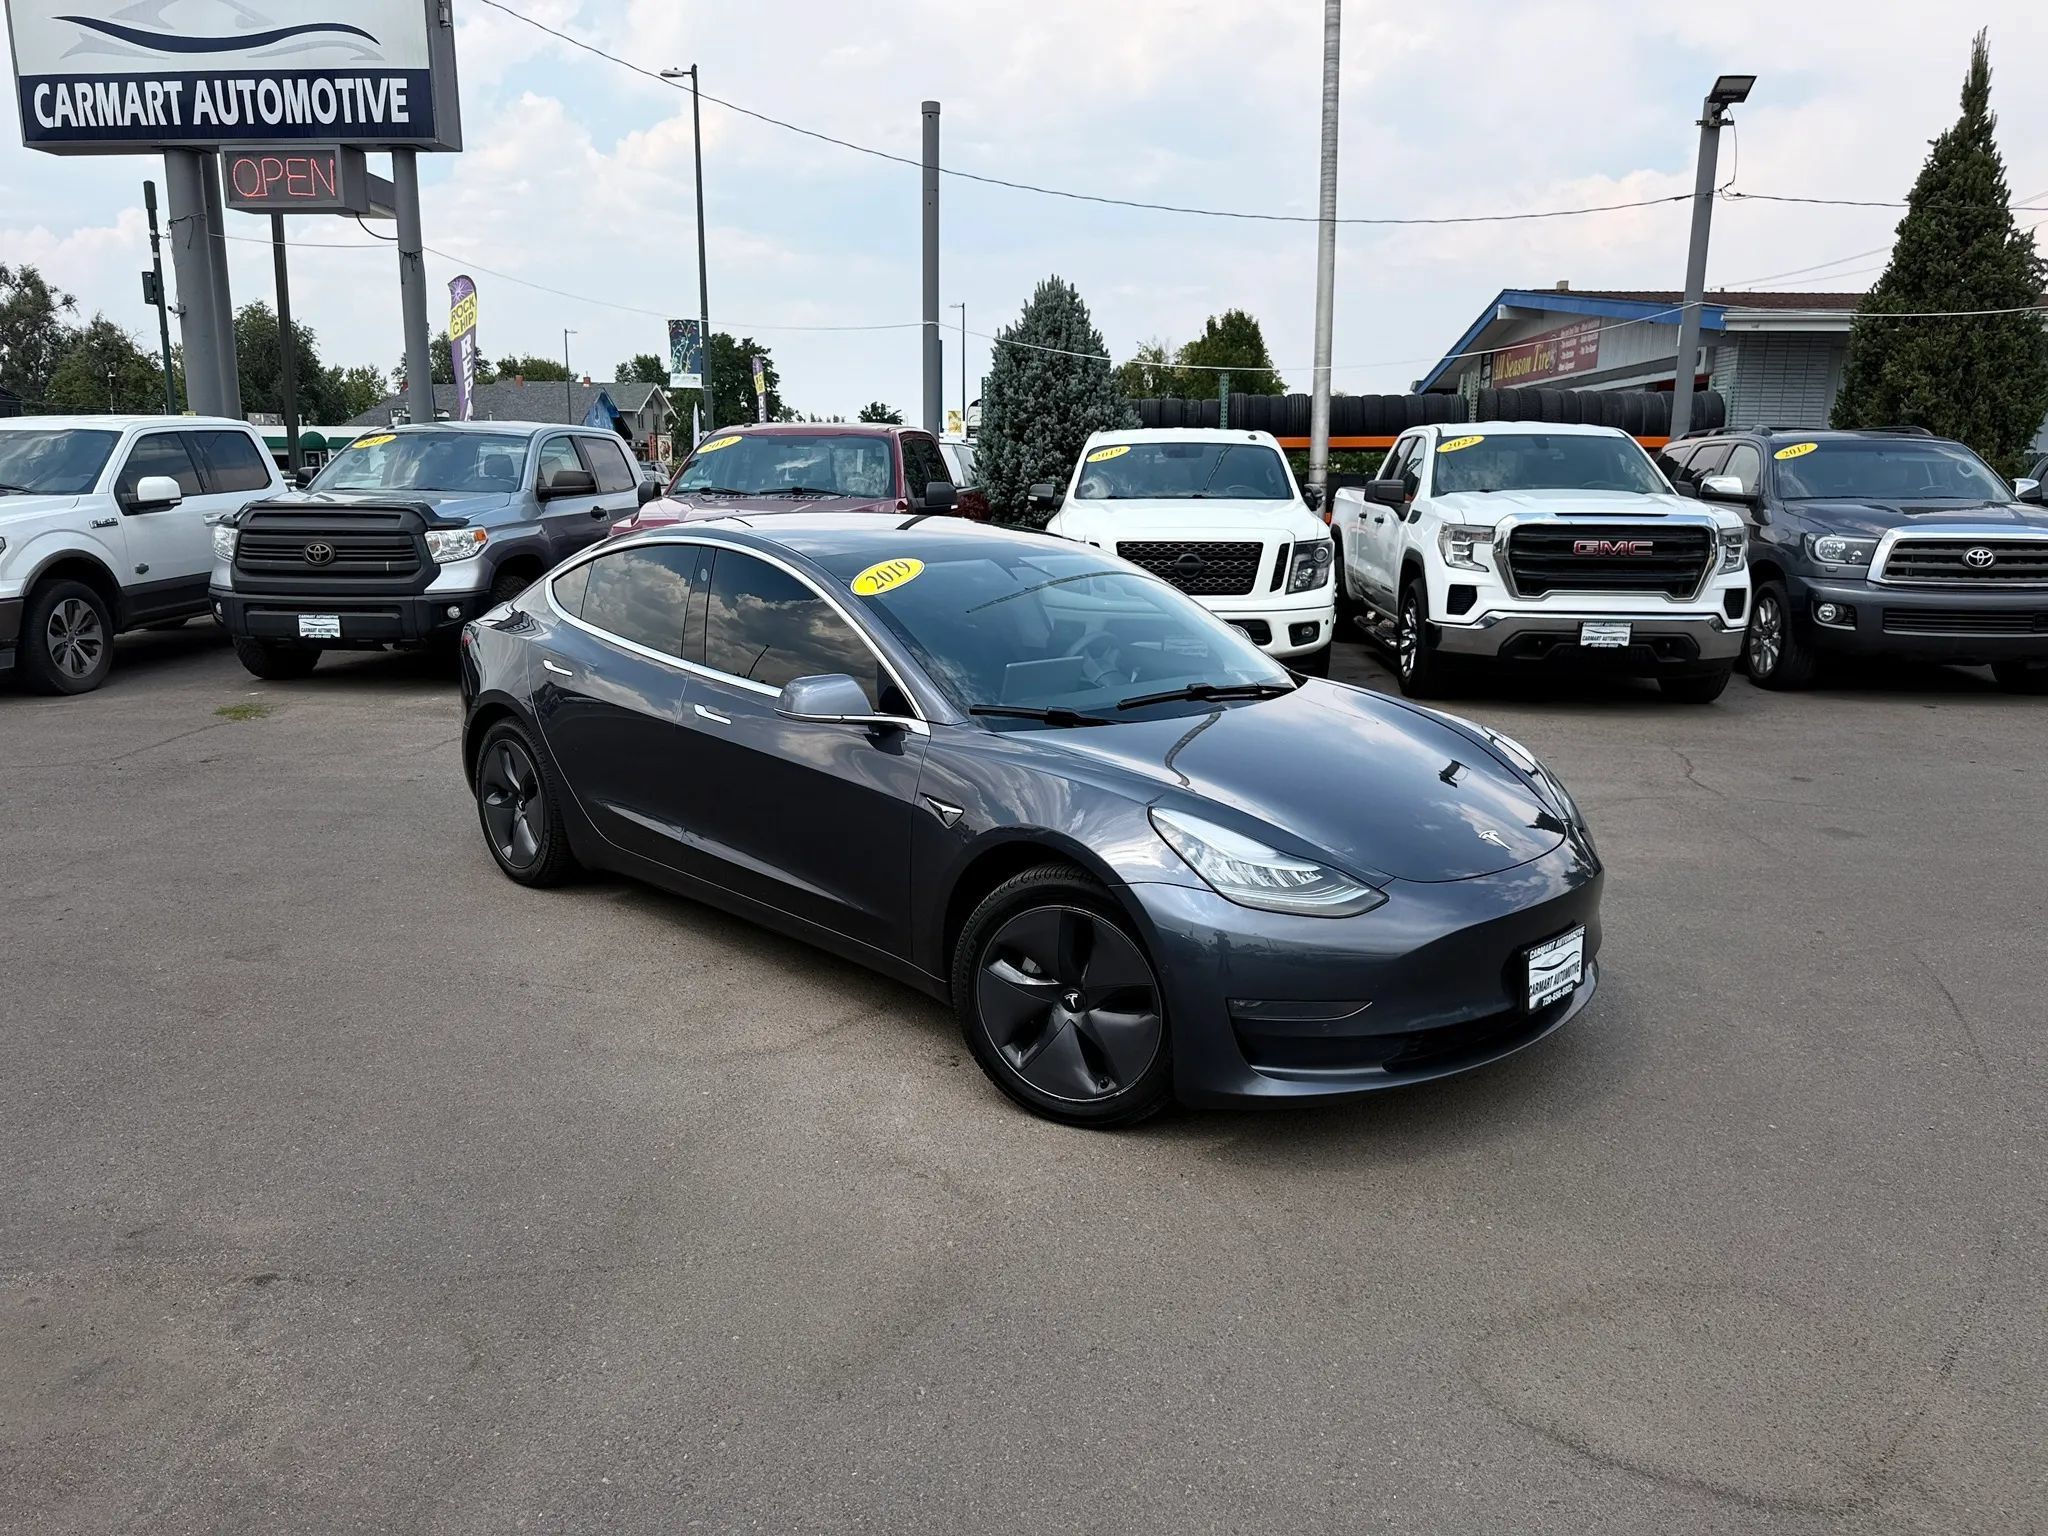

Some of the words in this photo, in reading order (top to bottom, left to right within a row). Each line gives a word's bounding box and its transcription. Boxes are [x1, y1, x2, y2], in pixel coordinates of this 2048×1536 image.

[34, 80, 183, 129] CARMART
[193, 78, 409, 126] AUTOMOTIVE
[232, 157, 336, 197] OPEN
[451, 297, 475, 322] ROCK
[452, 313, 474, 336] CHIP
[1505, 351, 1532, 378] Season
[1532, 343, 1551, 372] Tire
[1446, 437, 1475, 450] 2022
[1782, 444, 1807, 457] 2017
[1573, 540, 1654, 556] GMC
[865, 561, 911, 590] 2019
[1529, 941, 1556, 960] CARMART
[1529, 975, 1554, 998] CARMART
